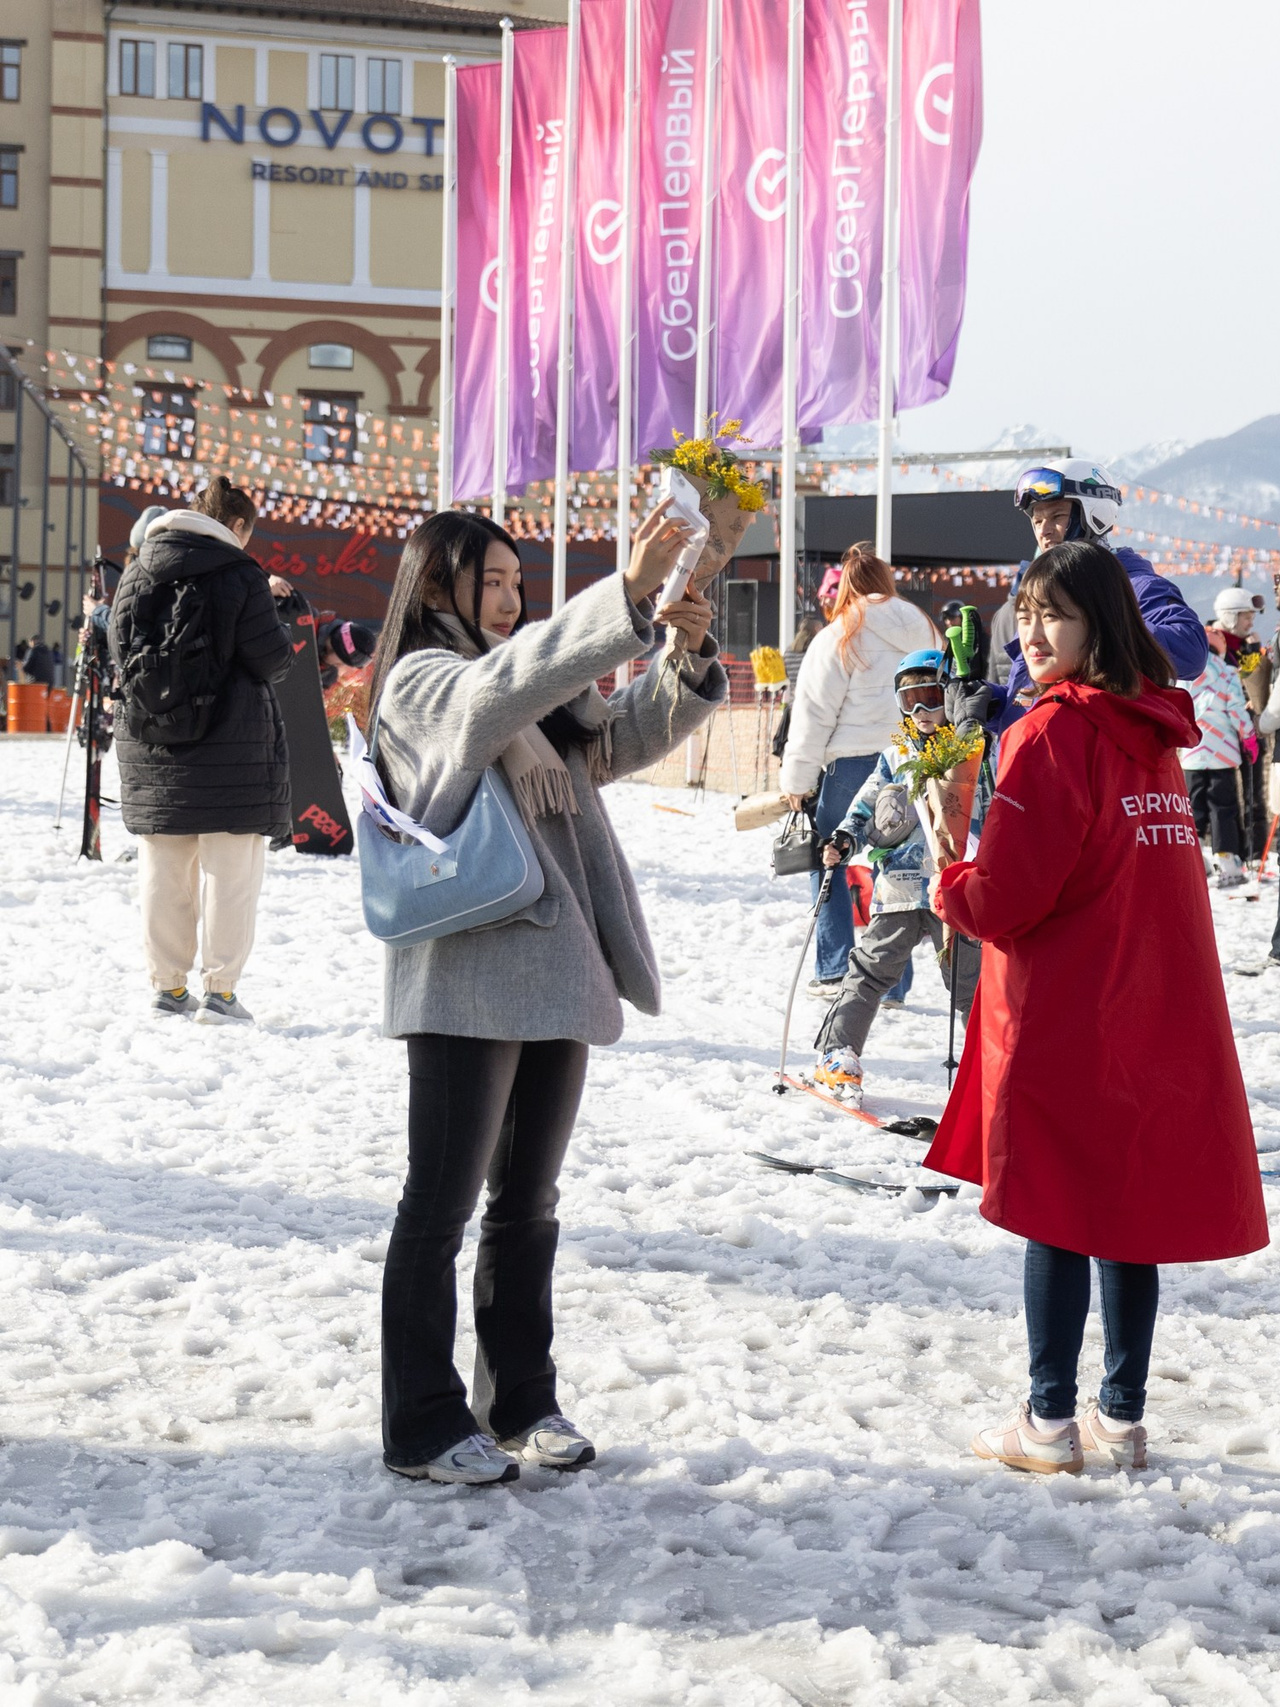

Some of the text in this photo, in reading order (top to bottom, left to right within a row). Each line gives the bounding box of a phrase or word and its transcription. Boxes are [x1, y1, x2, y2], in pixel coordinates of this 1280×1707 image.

[251, 160, 349, 186] RESORT
[356, 170, 409, 190] AND
[659, 49, 698, 362] СберПервый
[316, 525, 379, 577] ski
